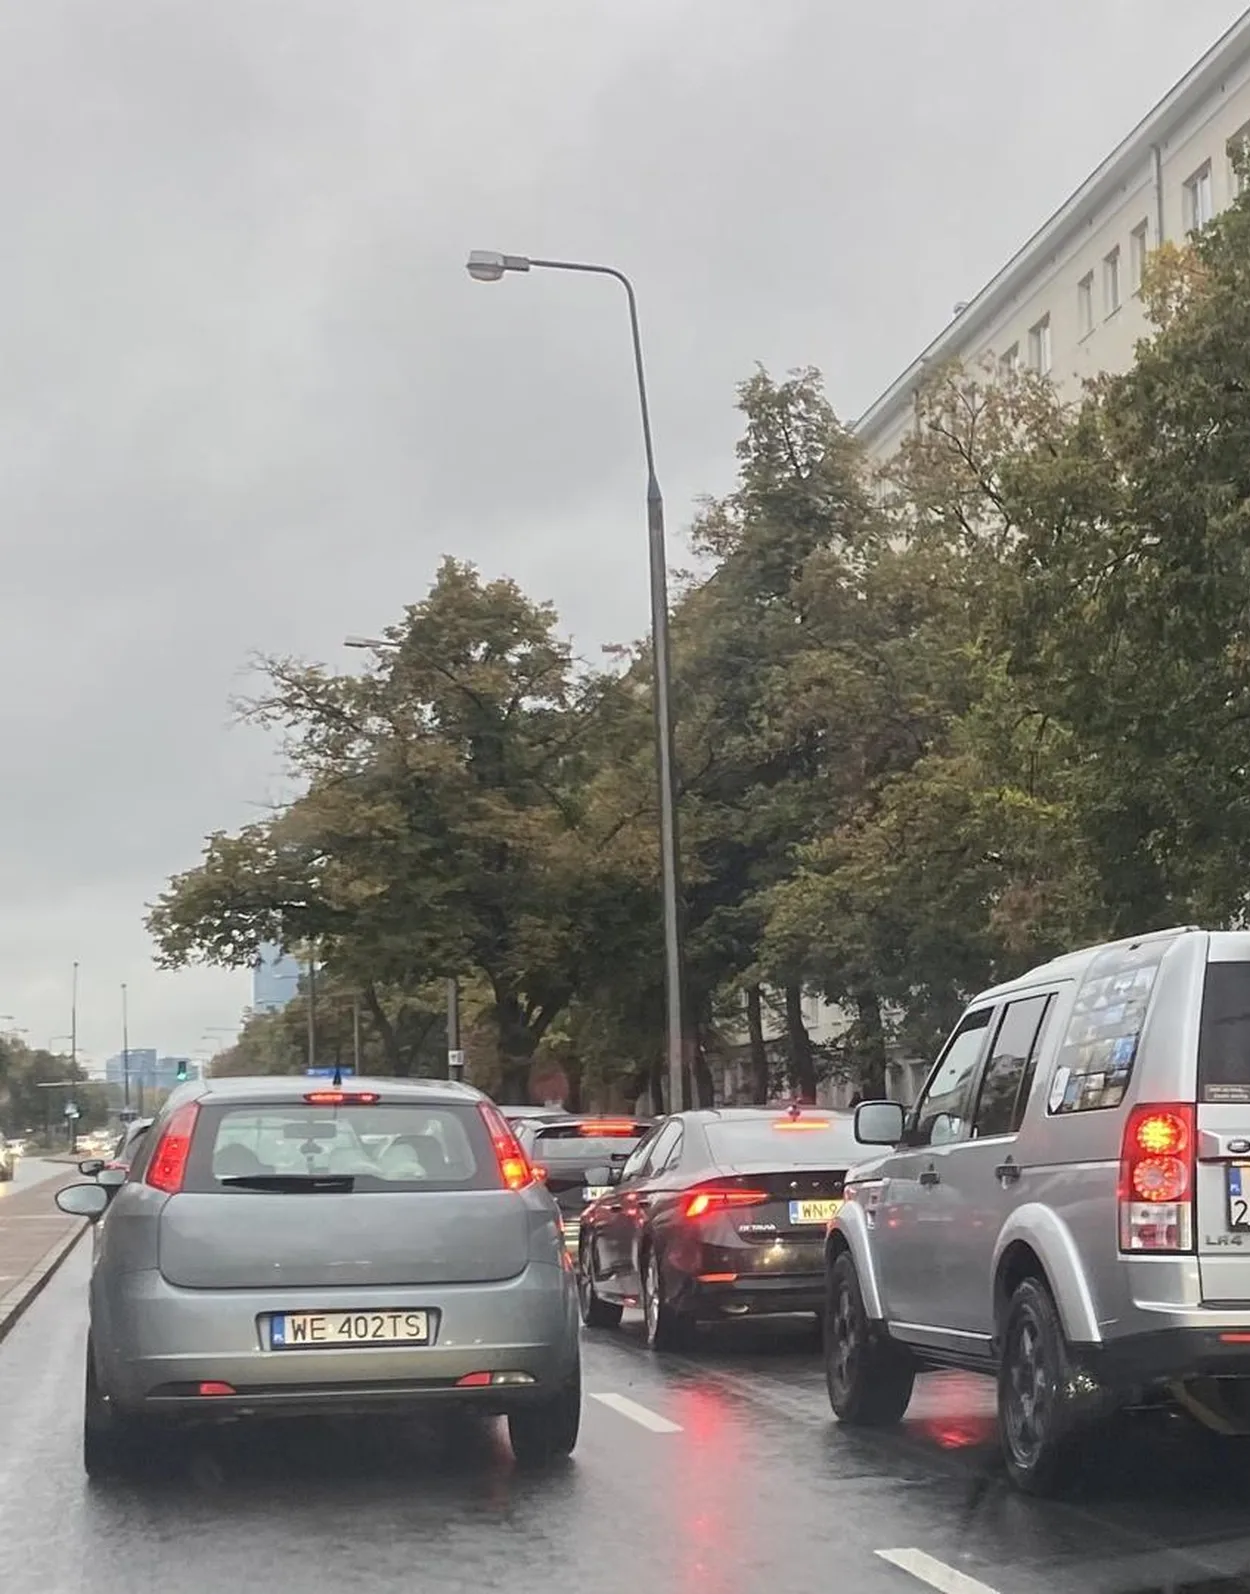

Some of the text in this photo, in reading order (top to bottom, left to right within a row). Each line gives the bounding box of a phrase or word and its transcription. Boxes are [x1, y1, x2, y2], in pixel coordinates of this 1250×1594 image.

[802, 1204, 823, 1218] WN
[1205, 1235, 1242, 1245] LR4
[291, 1314, 421, 1341] WE 402TS
